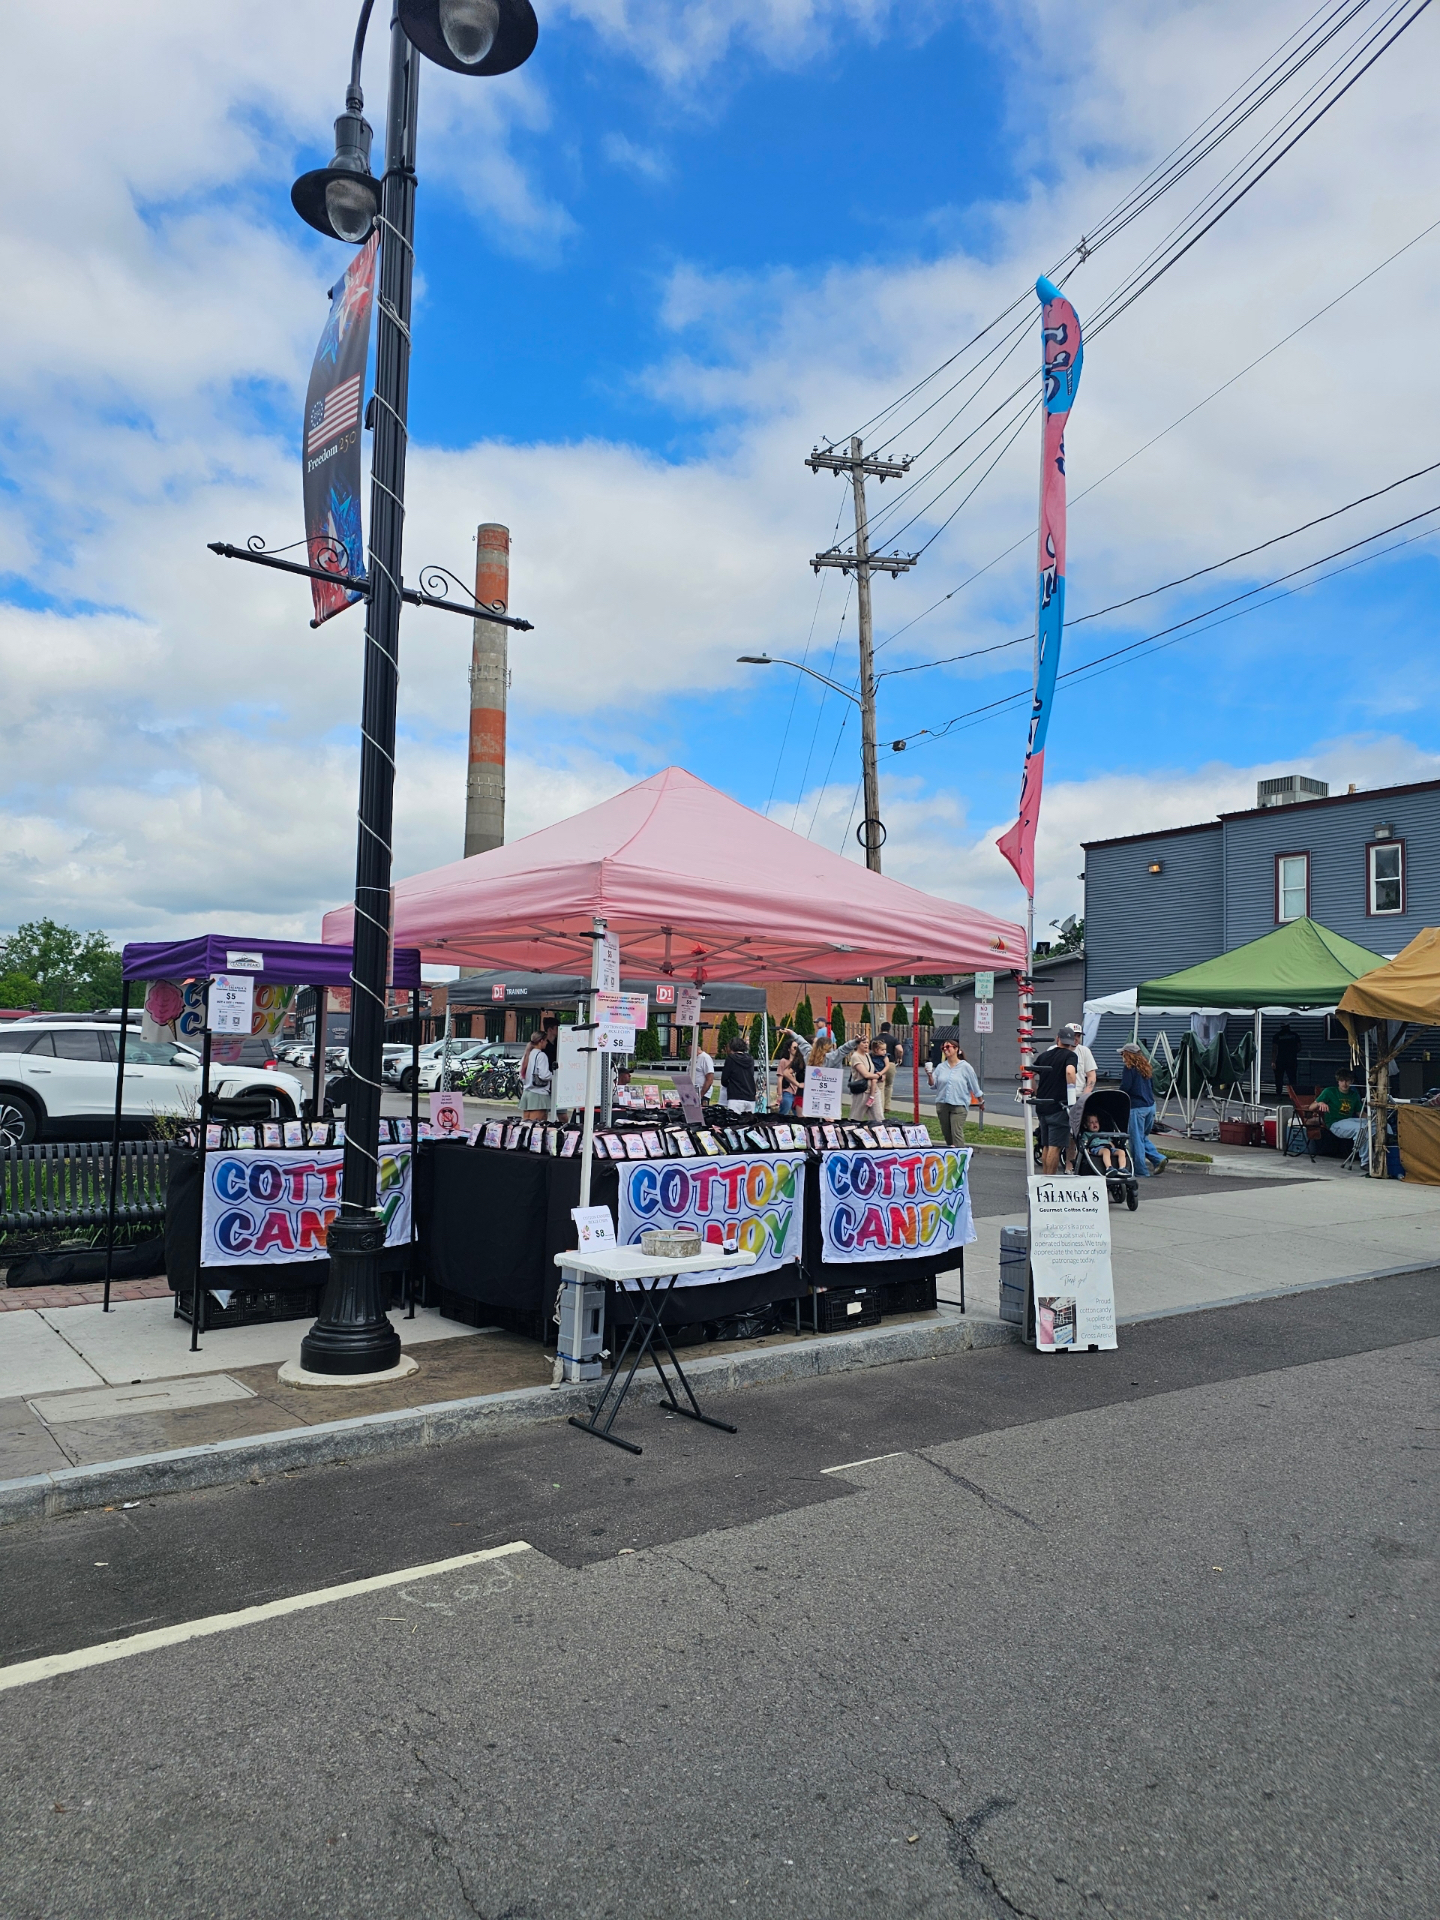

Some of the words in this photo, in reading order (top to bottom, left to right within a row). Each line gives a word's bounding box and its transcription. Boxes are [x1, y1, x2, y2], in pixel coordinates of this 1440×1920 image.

[308, 445, 338, 473] Freedom
[339, 430, 357, 453] 250
[226, 992, 236, 1000] $5
[493, 986, 504, 999] D1
[659, 987, 673, 1001] D1
[613, 1038, 624, 1047] $8
[819, 1081, 828, 1089] $5
[213, 1154, 412, 1206] COTTN
[826, 1152, 968, 1199] COTTON
[628, 1160, 804, 1217] COTTON
[1036, 1182, 1100, 1203] FALANGA'S
[831, 1196, 963, 1251] CANDY
[595, 1229, 605, 1238] $8
[1097, 1306, 1112, 1315] candy
